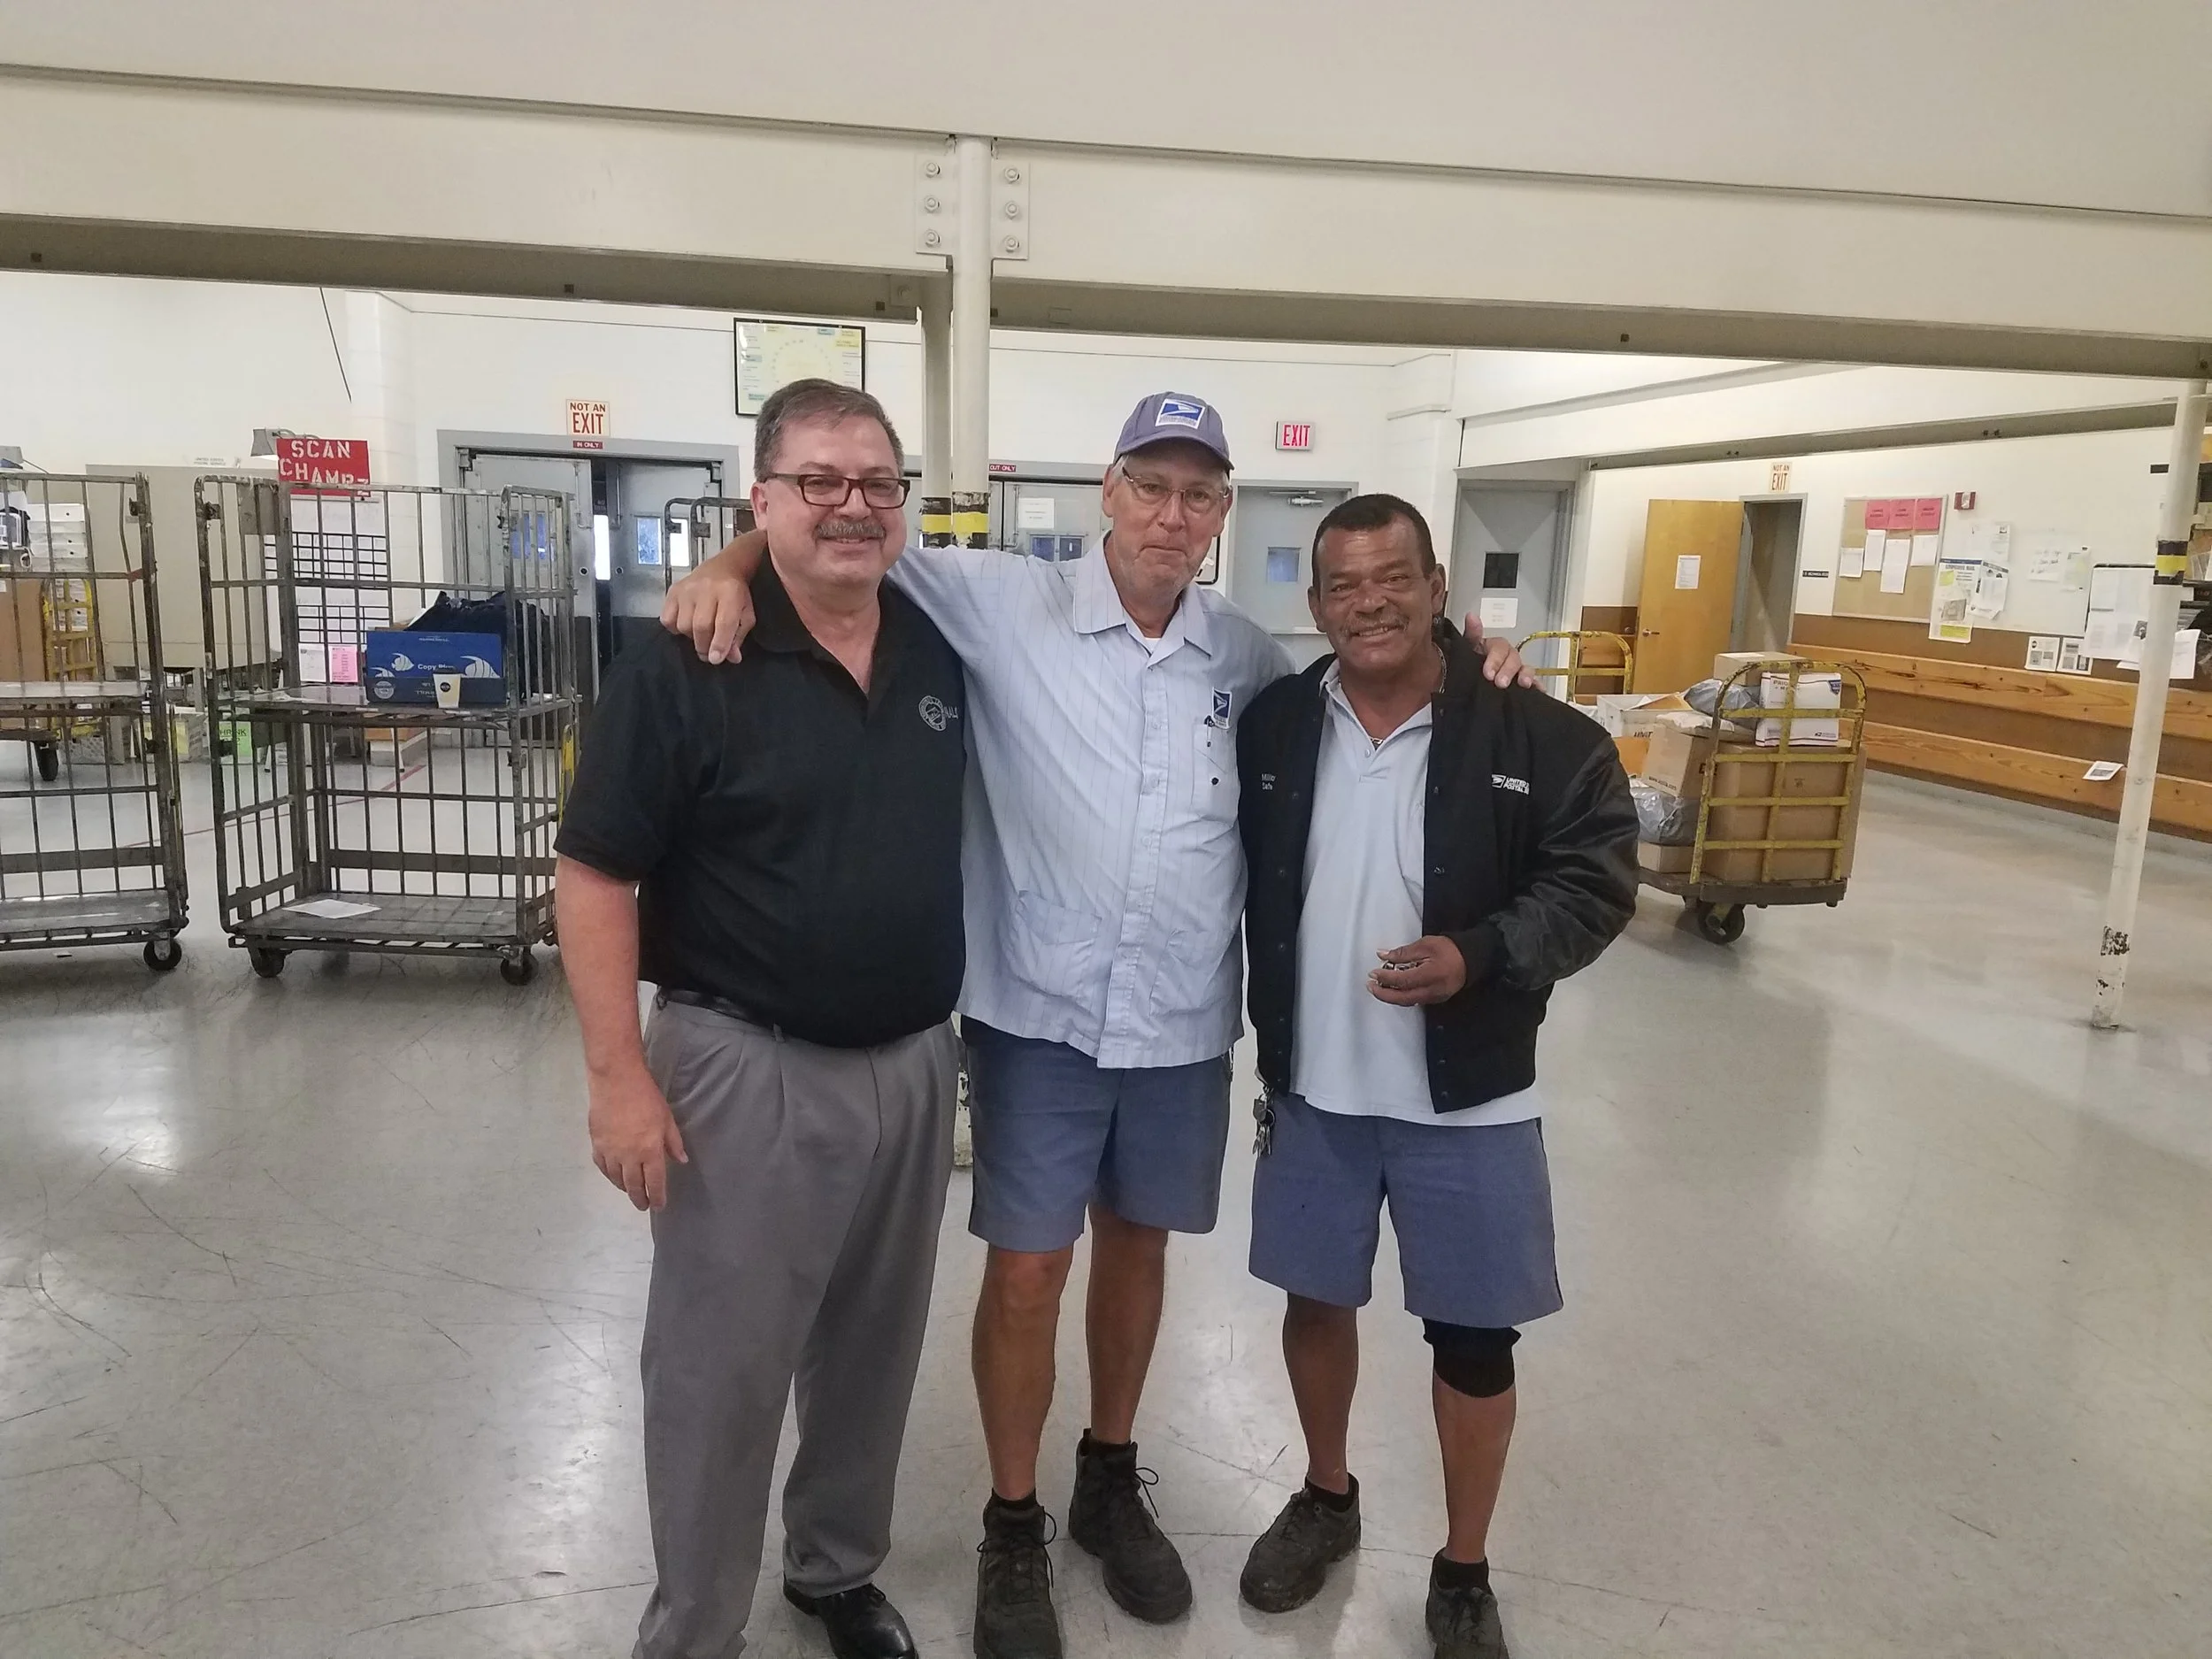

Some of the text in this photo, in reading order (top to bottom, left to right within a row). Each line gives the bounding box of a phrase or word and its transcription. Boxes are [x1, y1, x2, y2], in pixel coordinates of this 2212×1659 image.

[570, 403, 606, 412] NOT AN
[572, 412, 603, 434] EXIT
[1283, 425, 1310, 447] EXIT
[291, 440, 351, 459] SCAN
[1772, 472, 1788, 491] EXIT
